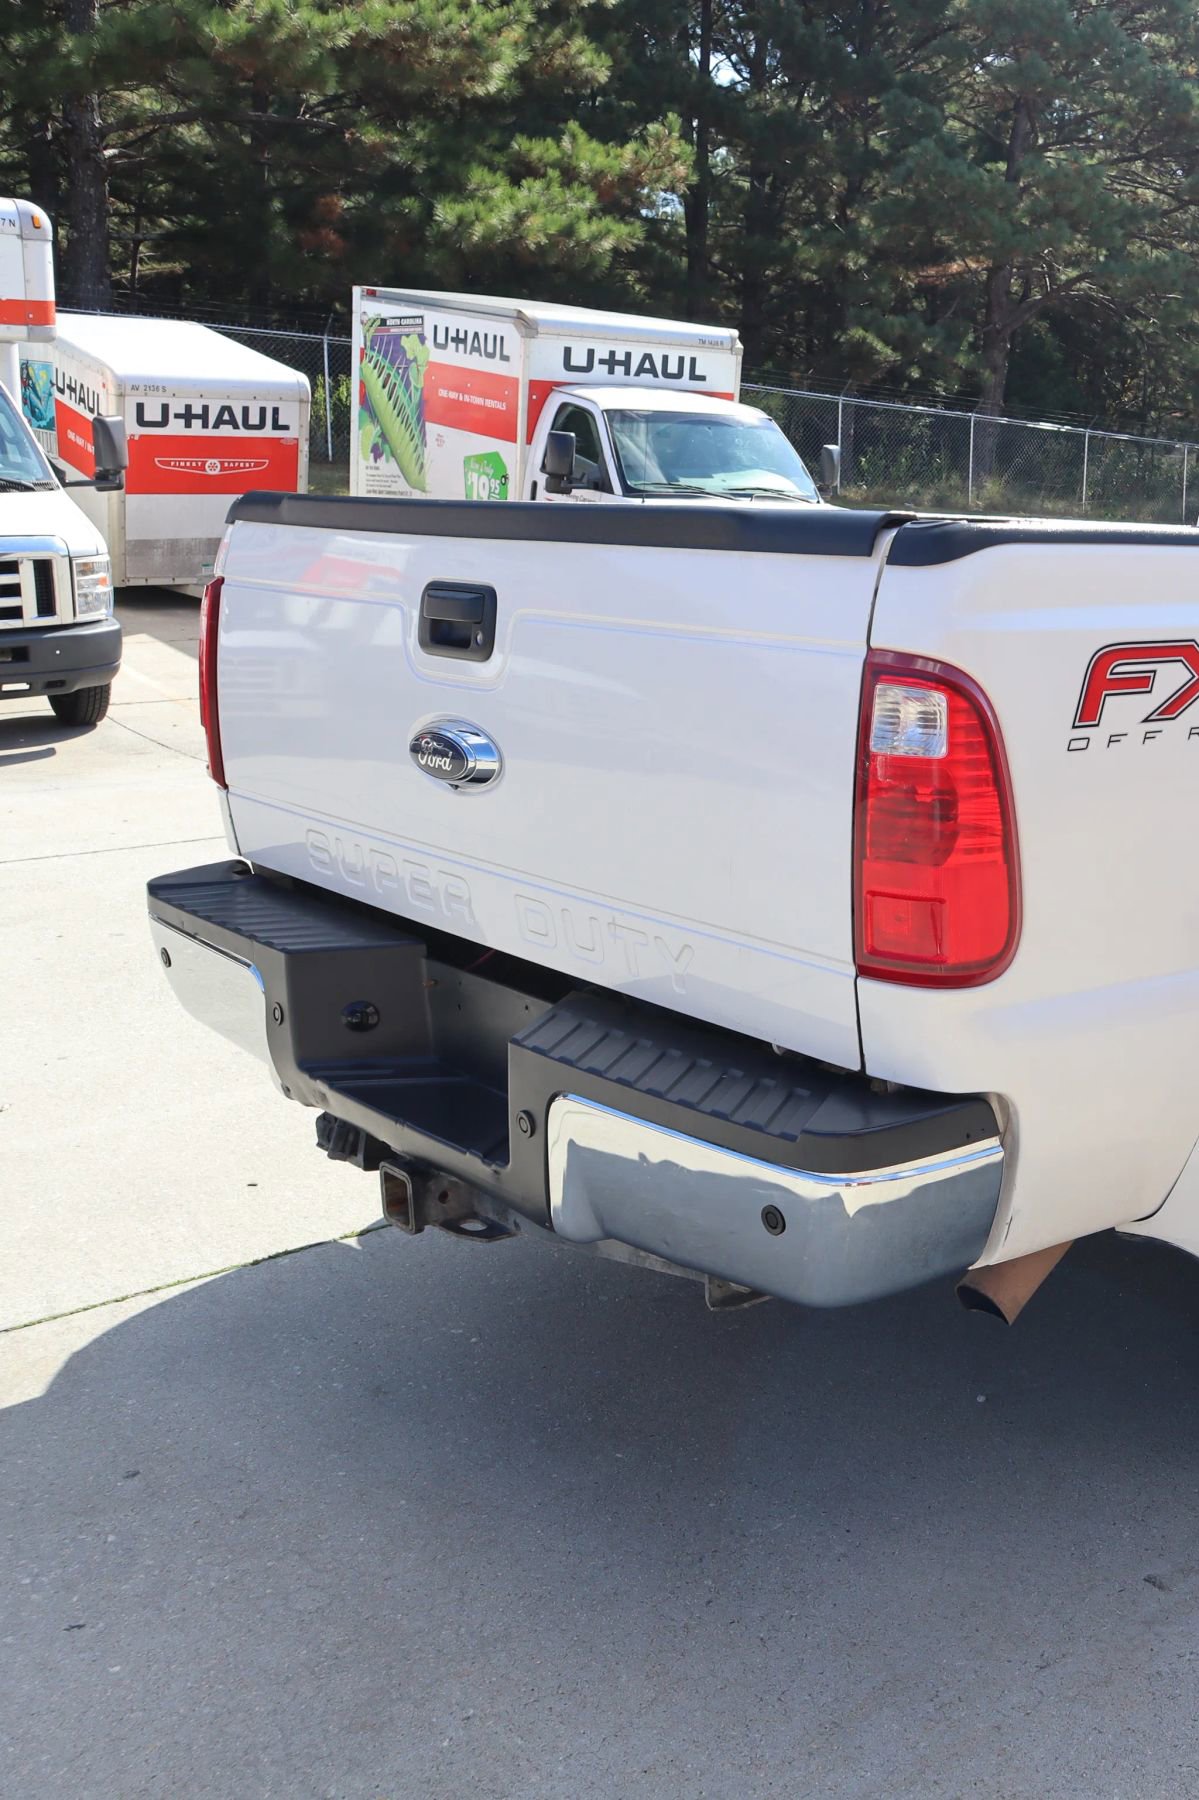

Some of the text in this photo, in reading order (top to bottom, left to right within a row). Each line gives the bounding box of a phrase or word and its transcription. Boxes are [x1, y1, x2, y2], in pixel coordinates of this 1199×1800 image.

[485, 398, 506, 411] RENTALS
[418, 738, 453, 771] Ford
[305, 827, 696, 995] SUPER DUTY
